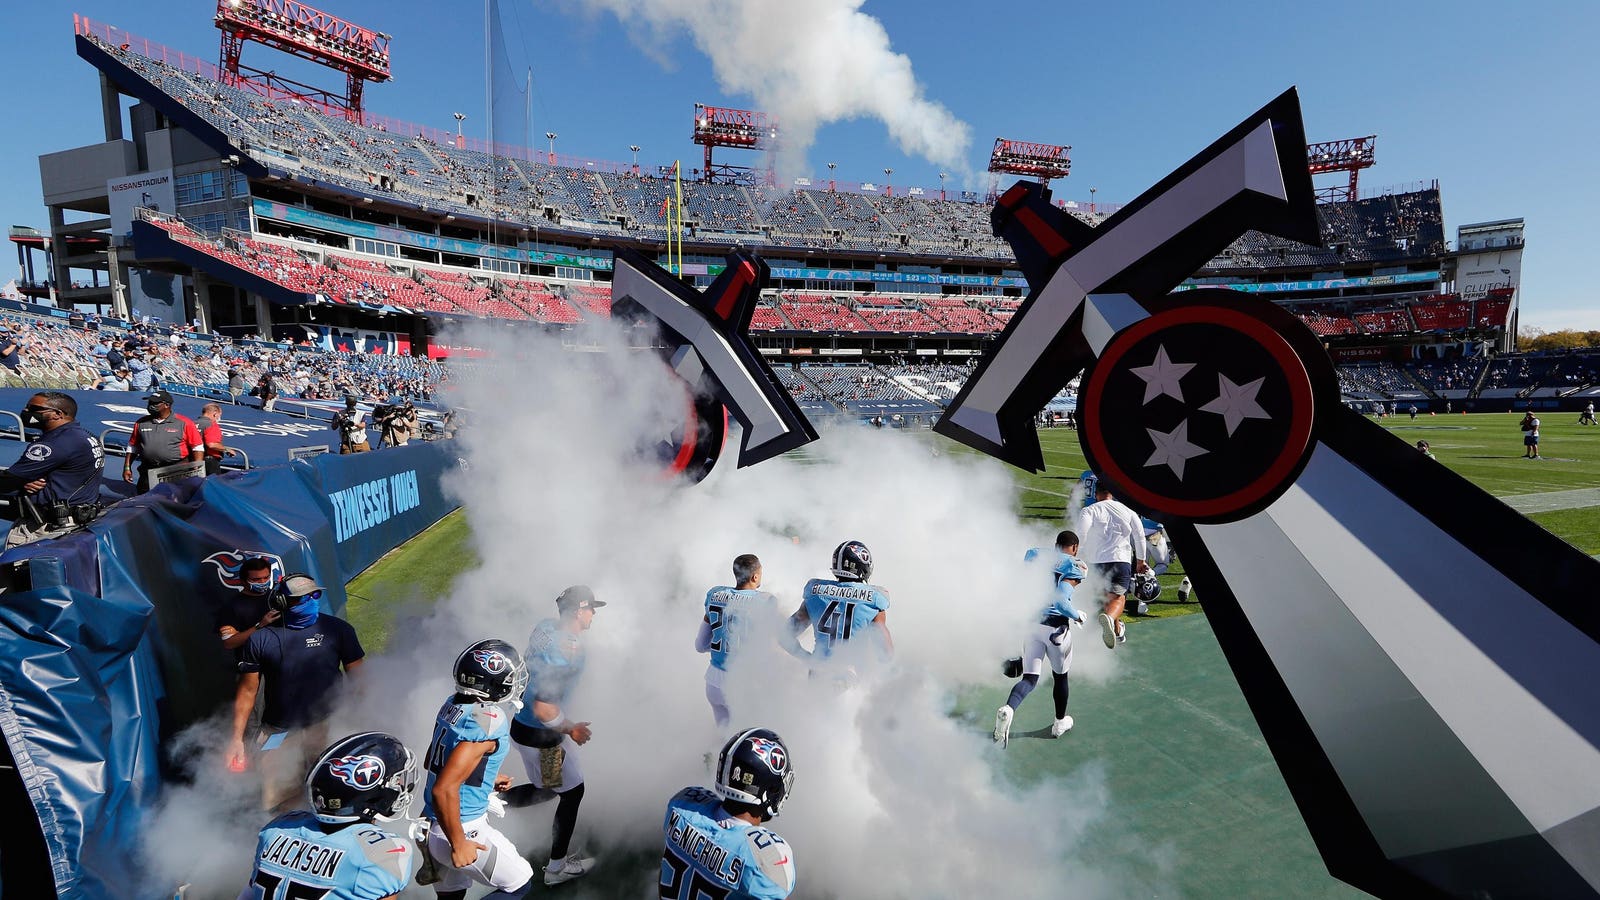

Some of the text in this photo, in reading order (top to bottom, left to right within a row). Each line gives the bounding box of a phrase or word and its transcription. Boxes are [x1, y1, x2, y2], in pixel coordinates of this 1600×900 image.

[1464, 281, 1510, 293] CLUTCH
[328, 469, 420, 544] TENNESSEE TOUGH
[812, 584, 873, 602] BLASINGAME
[817, 600, 856, 649] 41
[261, 833, 345, 880] JACKSON
